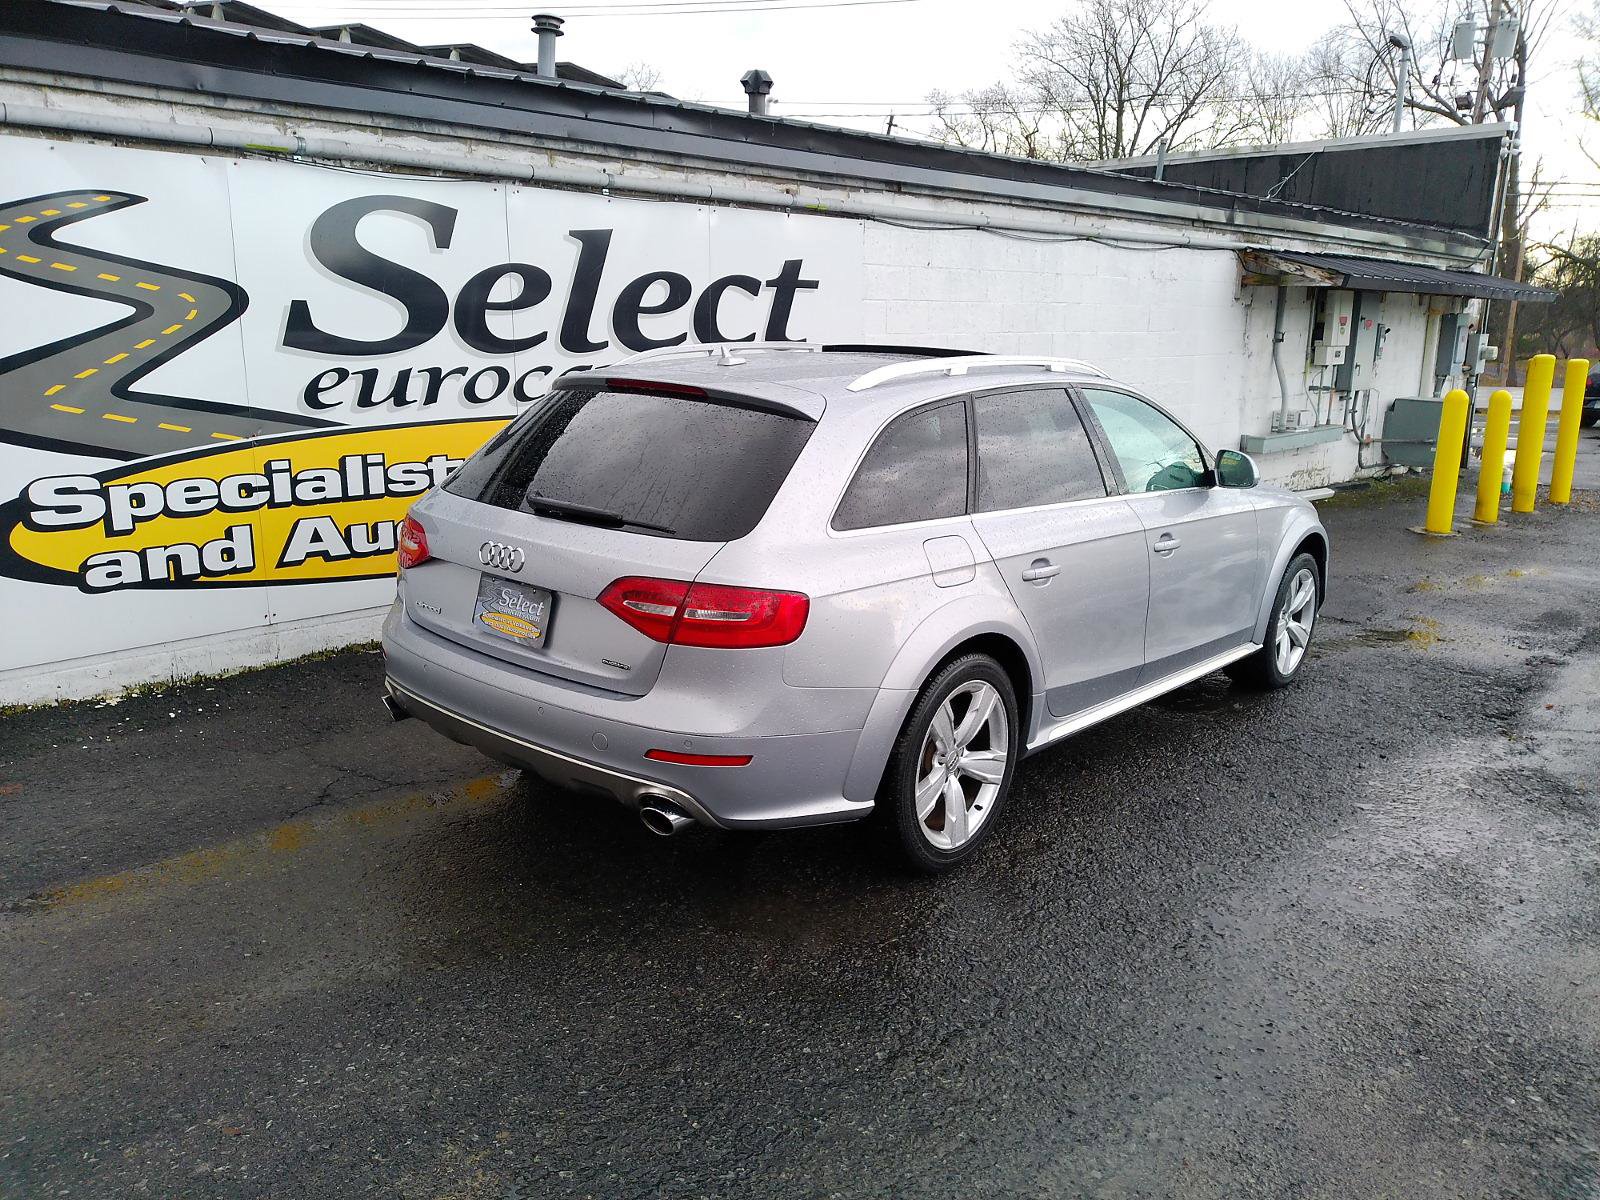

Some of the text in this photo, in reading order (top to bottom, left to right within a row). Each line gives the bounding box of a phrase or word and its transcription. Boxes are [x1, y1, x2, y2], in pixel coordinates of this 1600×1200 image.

[281, 194, 820, 354] Select
[302, 364, 611, 409] euroc
[83, 516, 404, 588] and Au
[499, 587, 545, 616] Select
